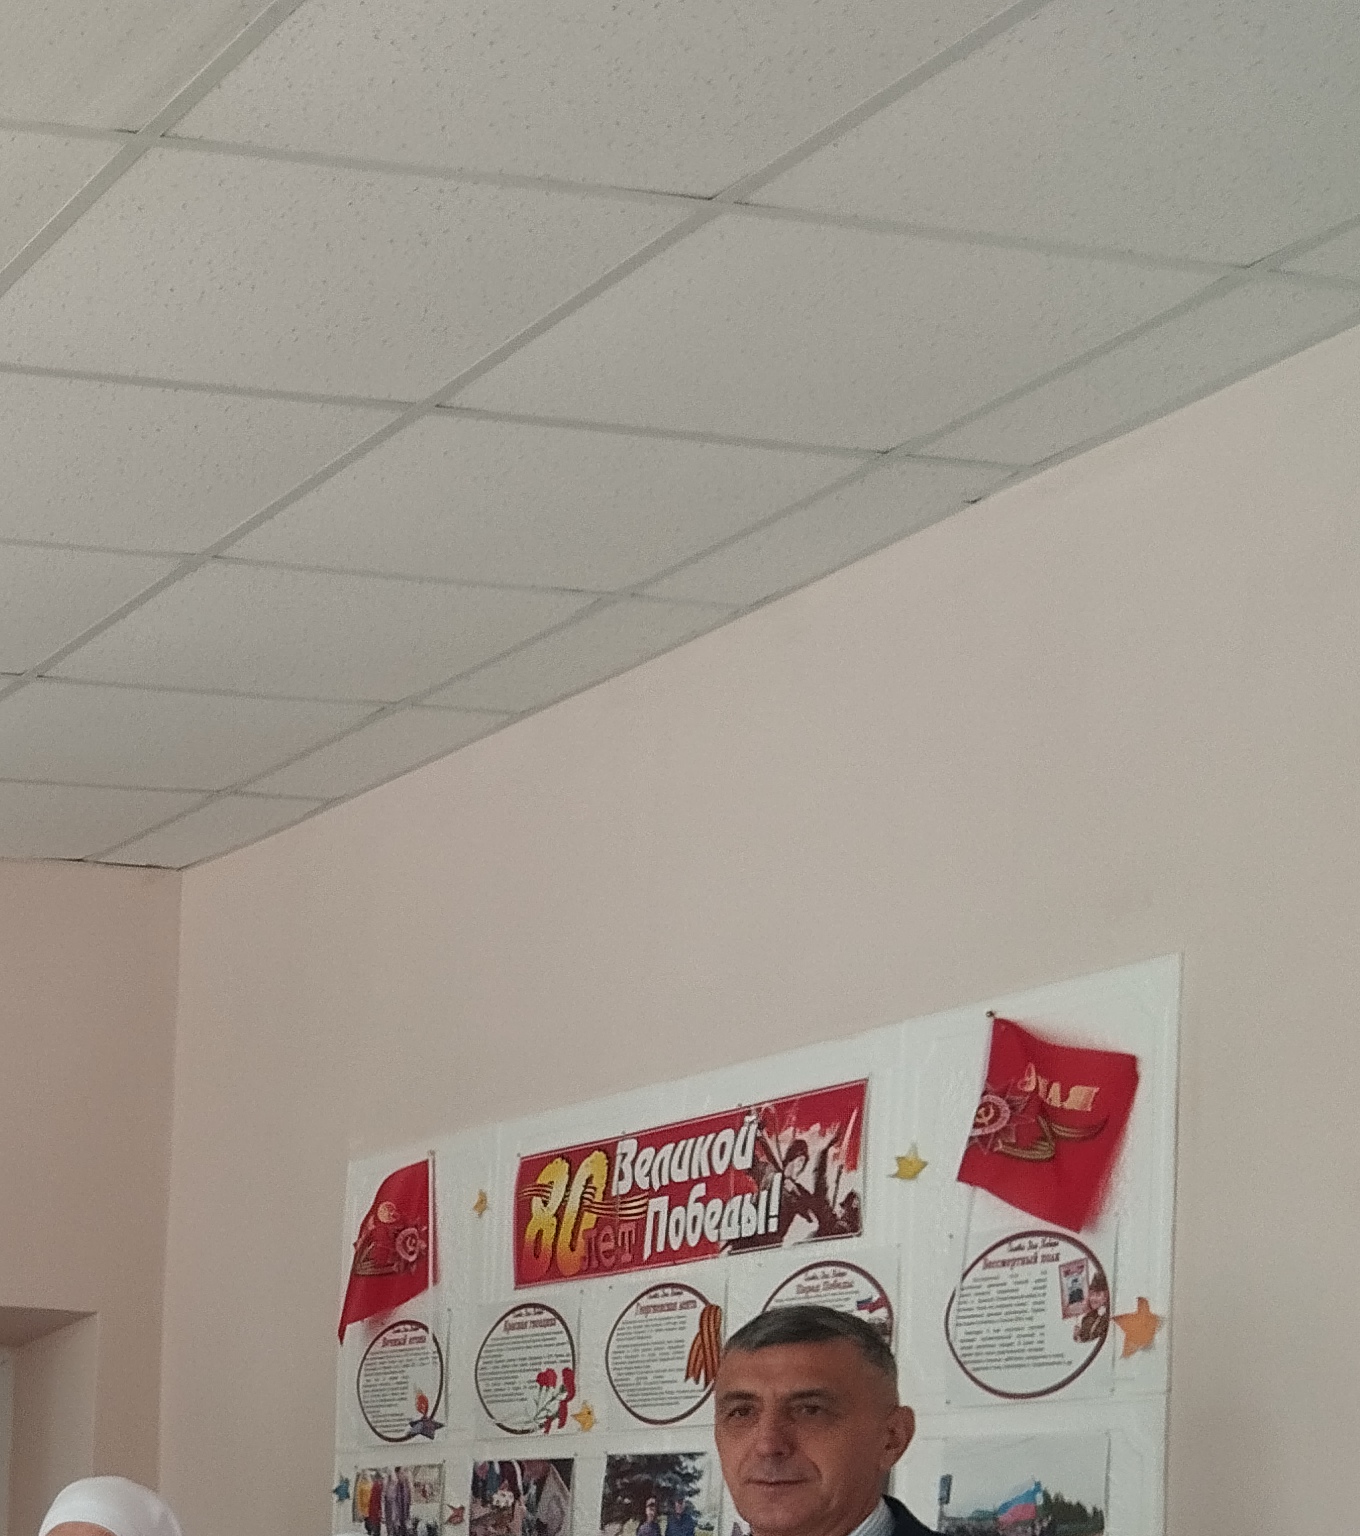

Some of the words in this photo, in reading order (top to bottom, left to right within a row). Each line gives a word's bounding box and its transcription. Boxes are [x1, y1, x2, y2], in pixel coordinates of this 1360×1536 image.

[611, 1114, 759, 1197] Великой
[523, 1150, 609, 1279] 80
[581, 1222, 636, 1271] лет
[642, 1172, 783, 1262] Победы!
